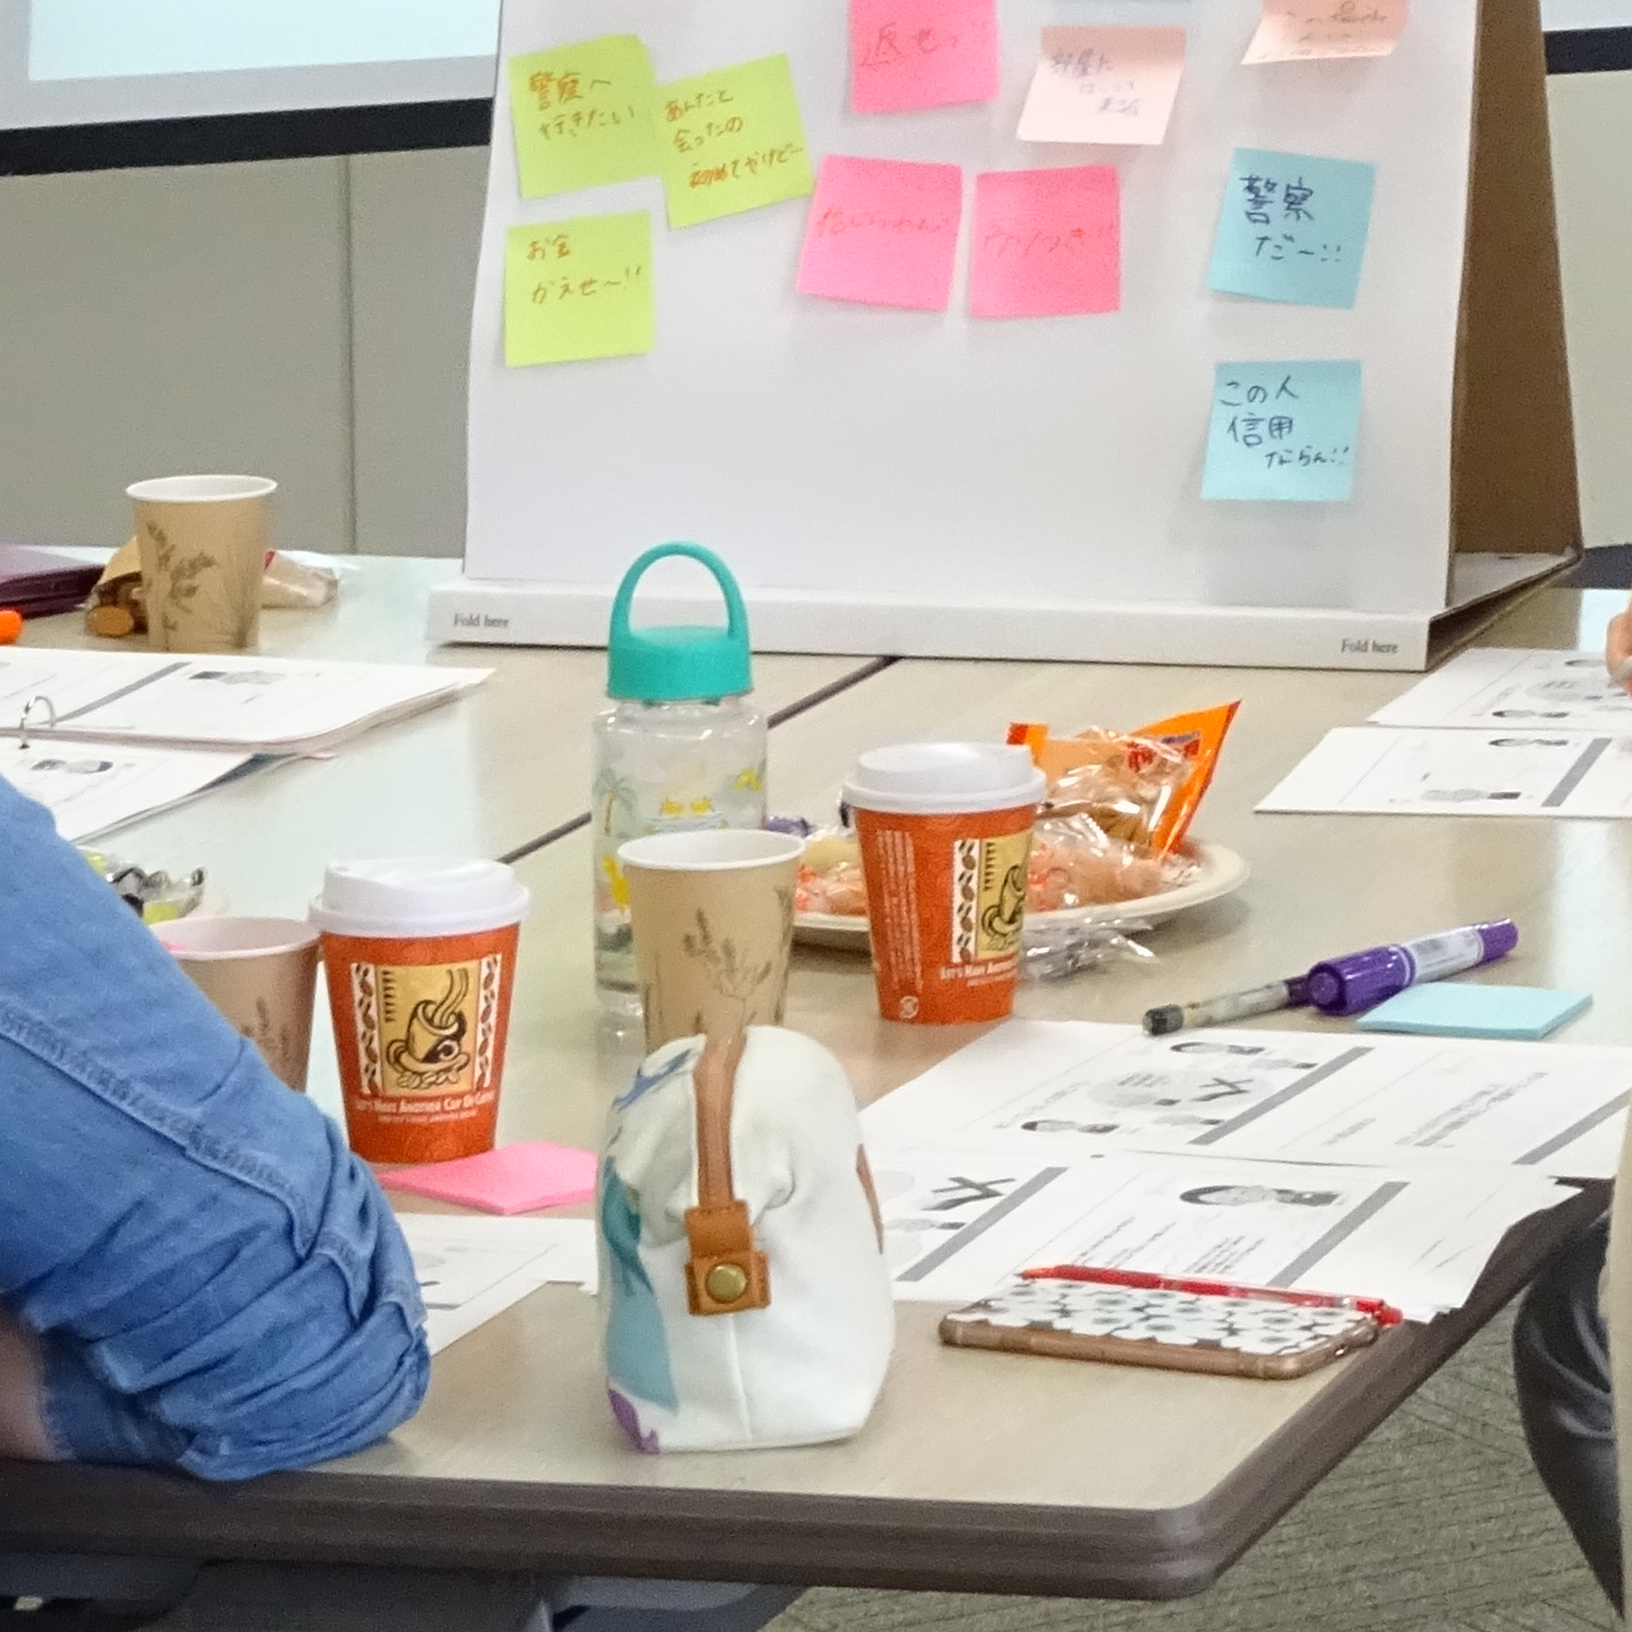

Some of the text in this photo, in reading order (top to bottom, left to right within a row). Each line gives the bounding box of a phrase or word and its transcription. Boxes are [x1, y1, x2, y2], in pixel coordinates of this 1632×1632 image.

[1238, 174, 1315, 225] 警察
[1218, 374, 1300, 407] この人
[1225, 411, 1295, 449] 信用
[453, 612, 511, 628] Fold here
[1340, 637, 1399, 654] Fold here
